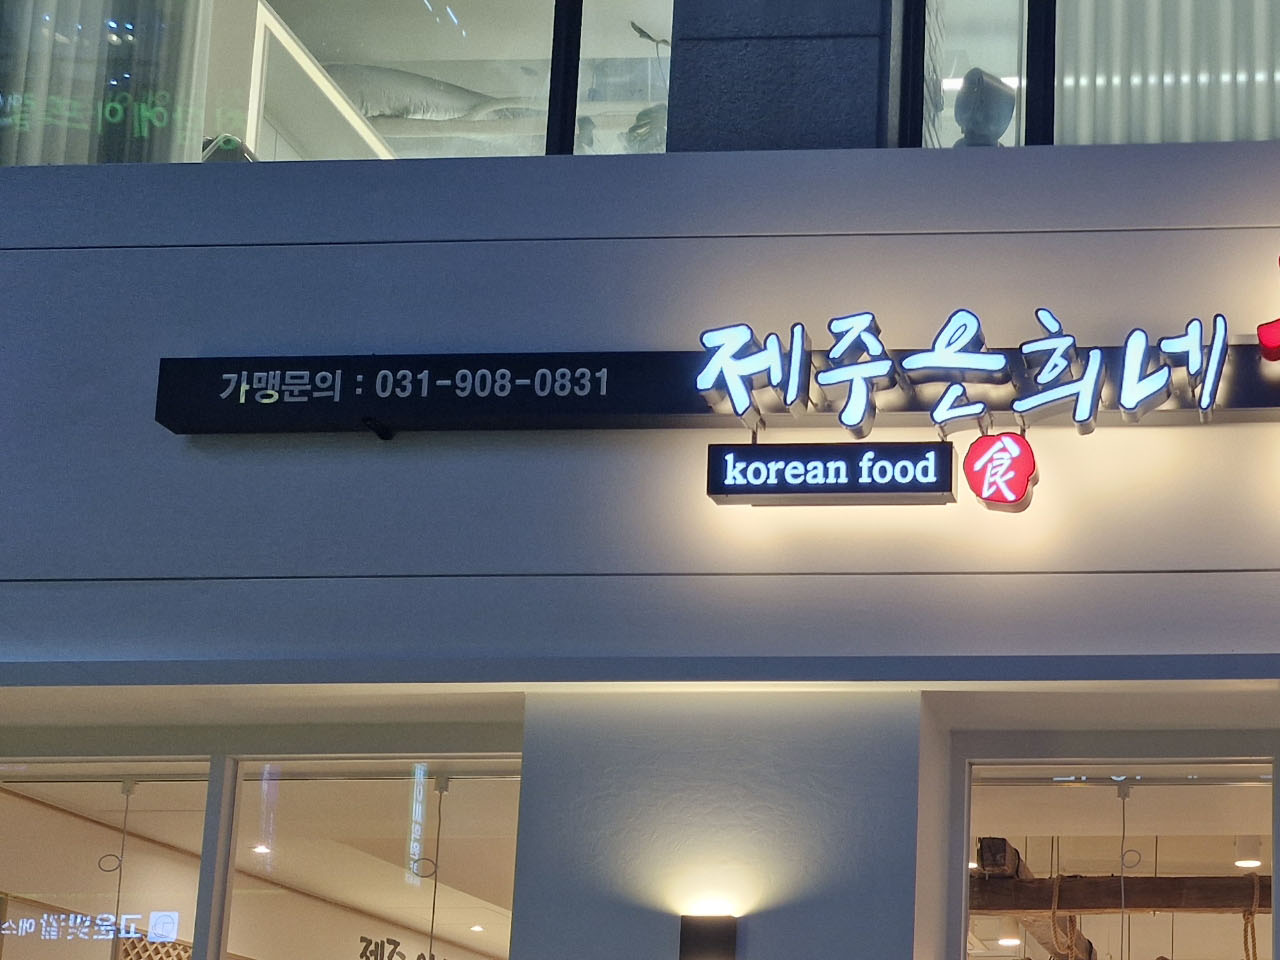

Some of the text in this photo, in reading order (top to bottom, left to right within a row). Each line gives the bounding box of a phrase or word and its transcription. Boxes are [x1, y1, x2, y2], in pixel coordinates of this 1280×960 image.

[219, 370, 342, 404] 가맹문의
[375, 368, 609, 398] 031-908-0831
[696, 309, 1228, 430] 제주은희네
[724, 451, 938, 486] korean food
[973, 436, 1023, 501] 食
